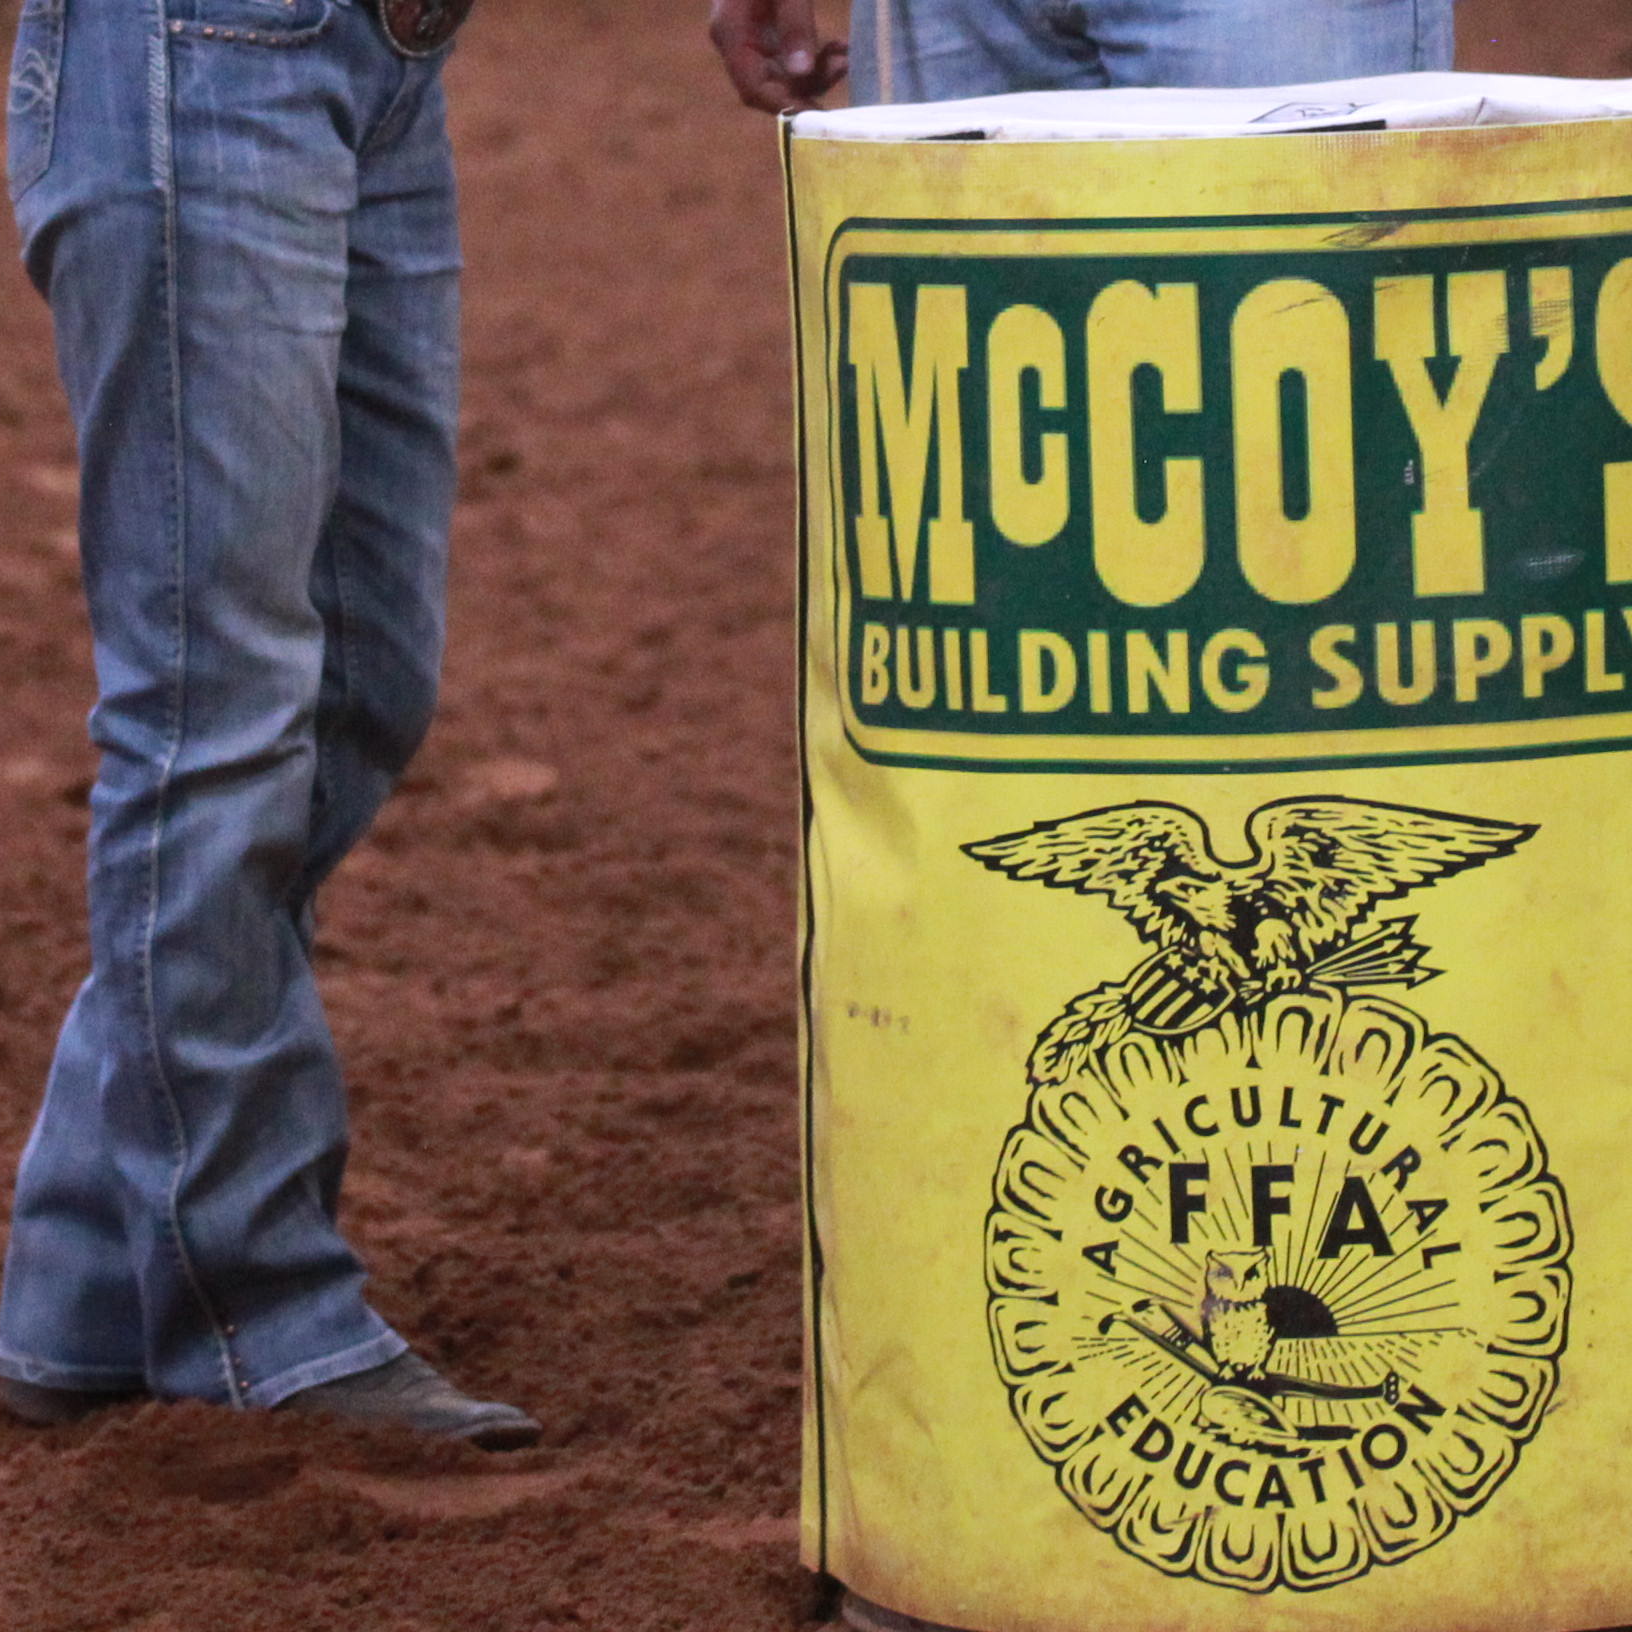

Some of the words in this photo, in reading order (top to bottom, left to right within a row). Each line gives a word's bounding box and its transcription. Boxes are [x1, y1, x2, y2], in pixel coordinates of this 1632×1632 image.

[859, 621, 1271, 714] BUILDING
[1081, 1085, 1462, 1277] AGRICULTURAL
[1168, 1161, 1395, 1260] FFA
[1106, 1384, 1448, 1509] EDUCATION
